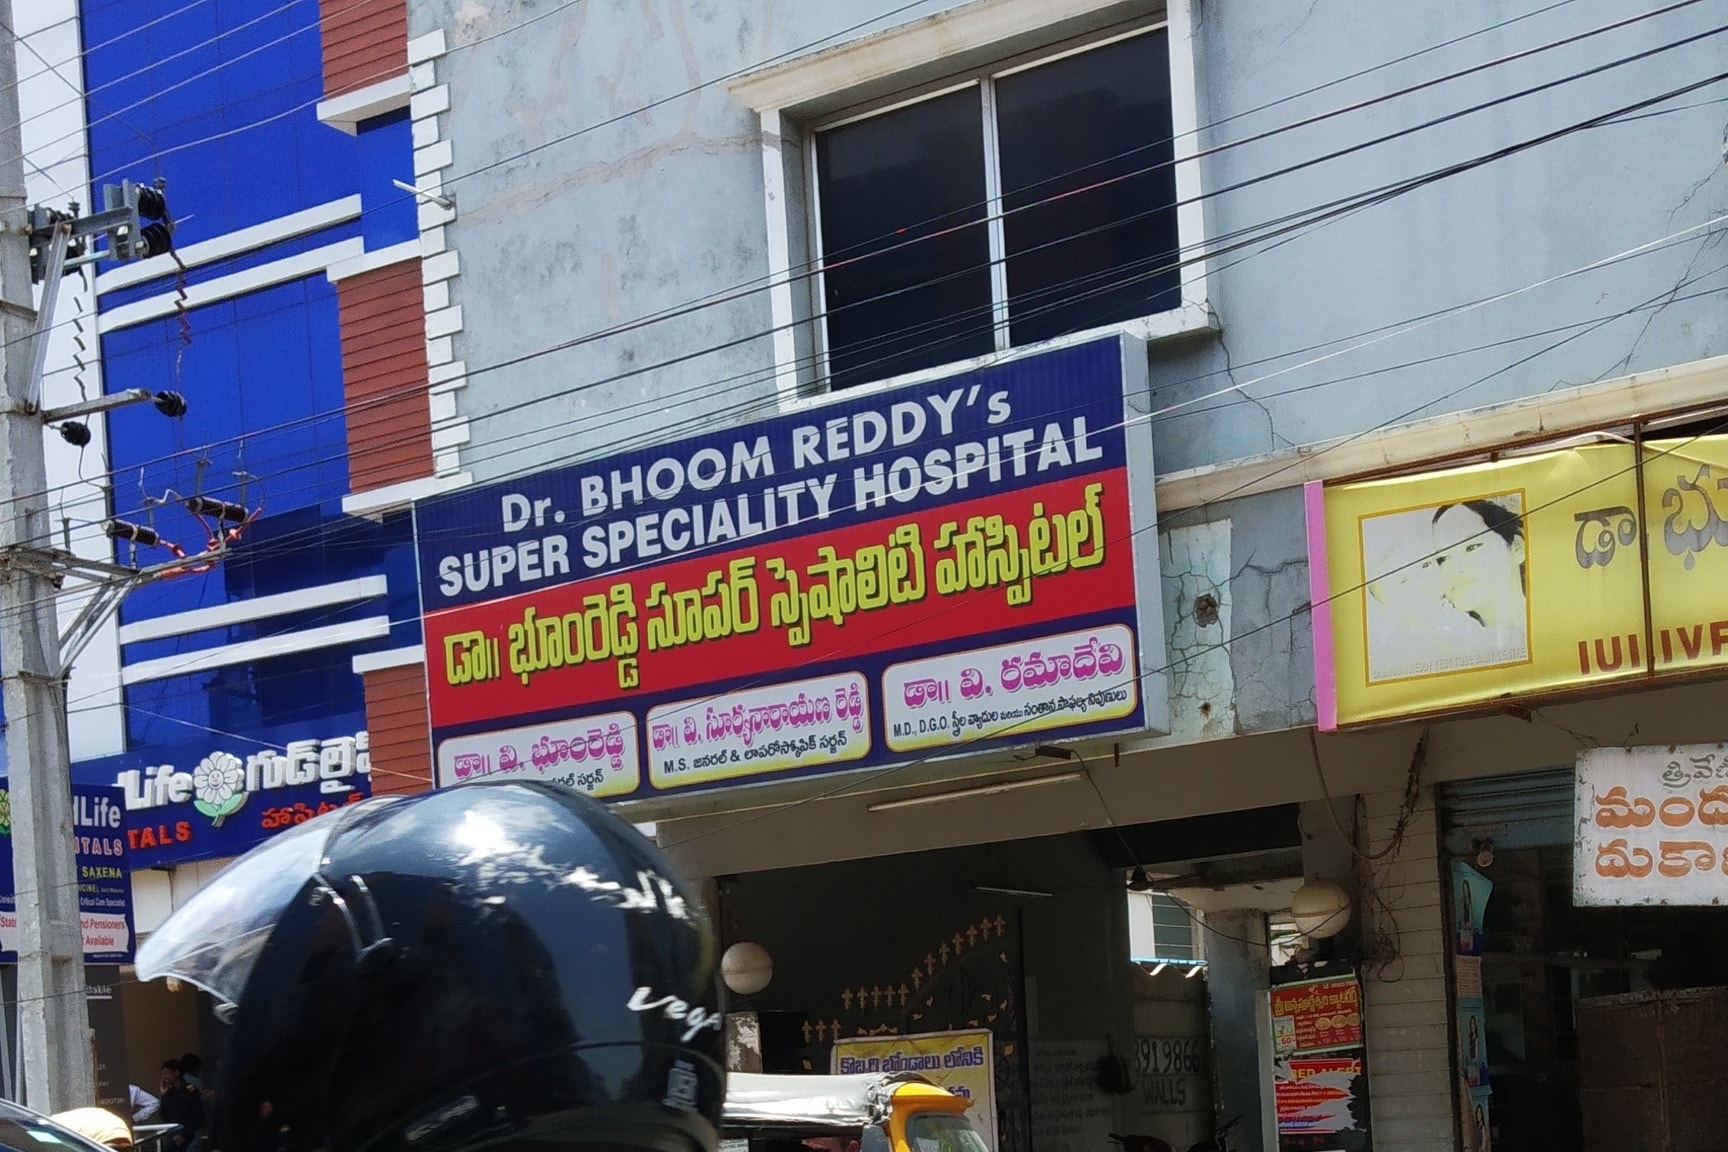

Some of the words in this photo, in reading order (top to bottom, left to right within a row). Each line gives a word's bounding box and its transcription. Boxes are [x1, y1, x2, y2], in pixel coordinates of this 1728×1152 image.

[438, 533, 571, 598] SUPER
[582, 473, 839, 569] SPECIALITY
[853, 415, 1104, 512] HOSPITAL
[501, 492, 566, 533] Dr.
[580, 435, 776, 518] BHOOM
[645, 556, 760, 653] సూపర్
[933, 482, 1105, 606] హాస్పిటల్
[1000, 636, 1126, 692] రమాదేవి
[1578, 633, 1641, 676] IUI
[664, 757, 691, 775] M.S.
[693, 749, 729, 769] జనరల్
[730, 750, 742, 762] &
[118, 765, 194, 811] Life
[82, 866, 122, 878] SAXENA
[1595, 838, 1728, 878] దుకా
